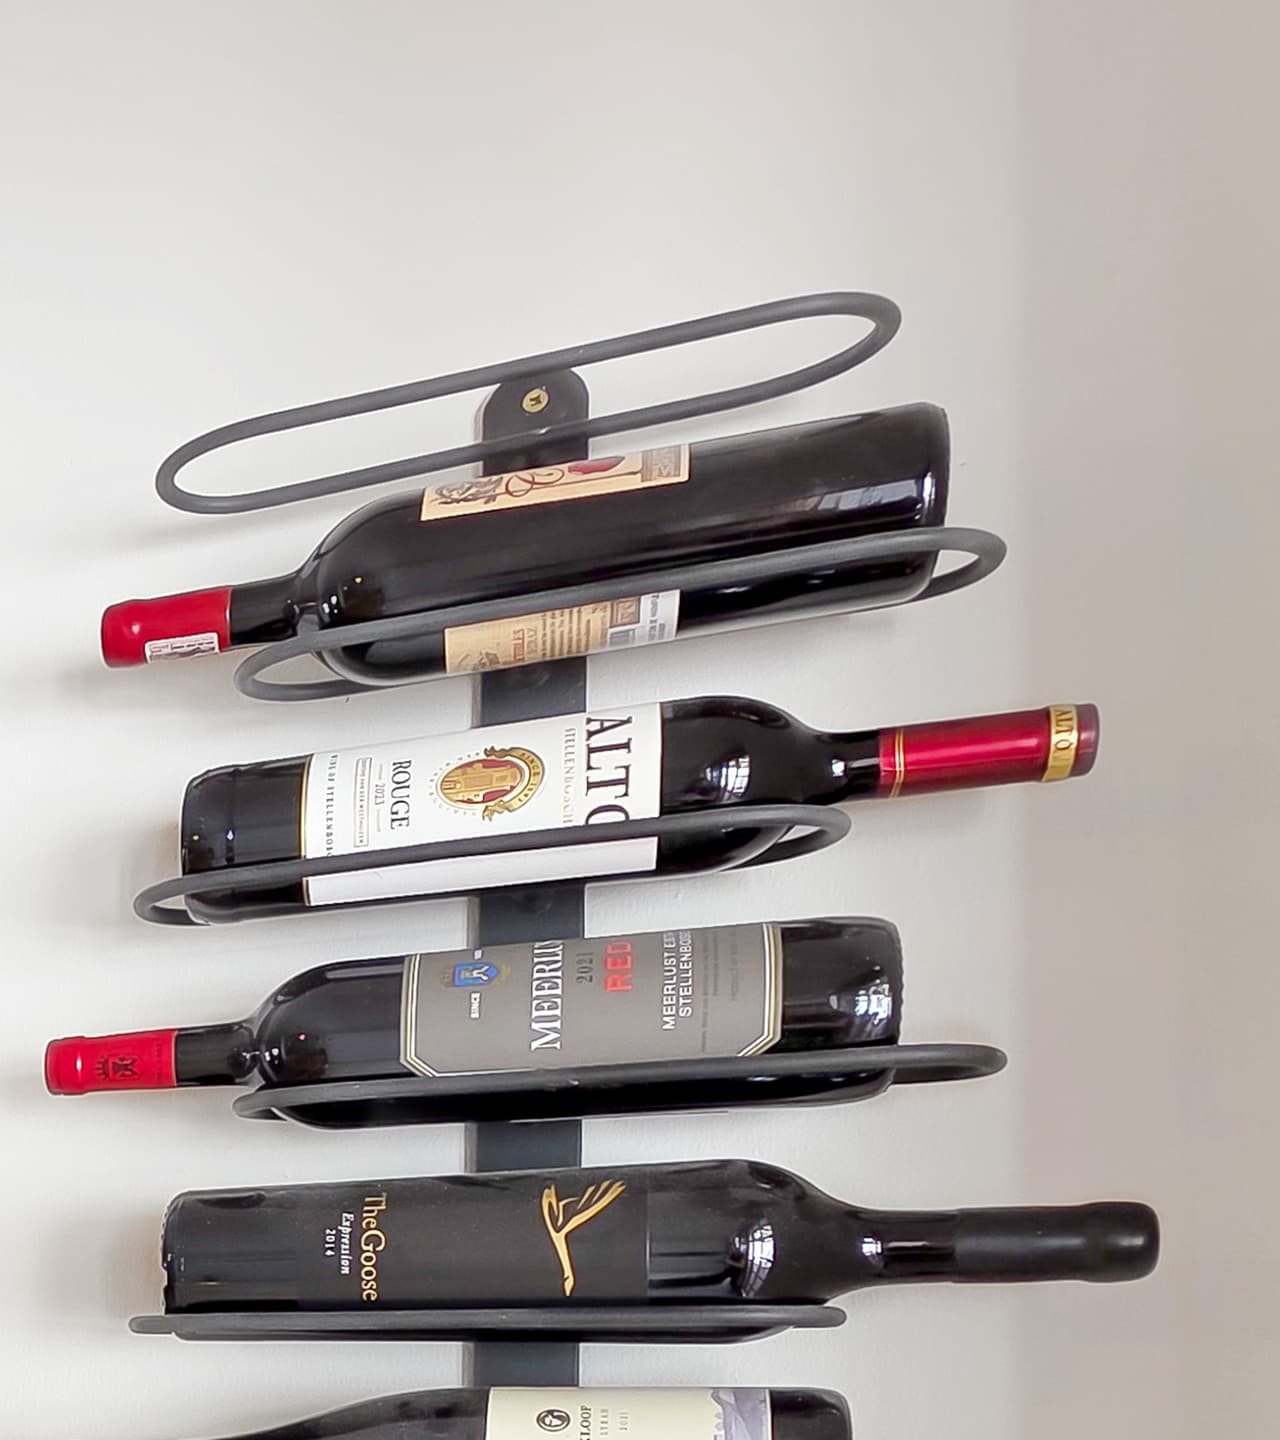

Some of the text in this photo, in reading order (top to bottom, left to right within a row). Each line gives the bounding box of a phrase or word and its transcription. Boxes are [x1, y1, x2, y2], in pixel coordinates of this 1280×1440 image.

[390, 760, 412, 830] ROUGE
[603, 941, 633, 993] RED
[661, 951, 677, 1030] MEERLUST
[323, 1228, 337, 1257] 2014
